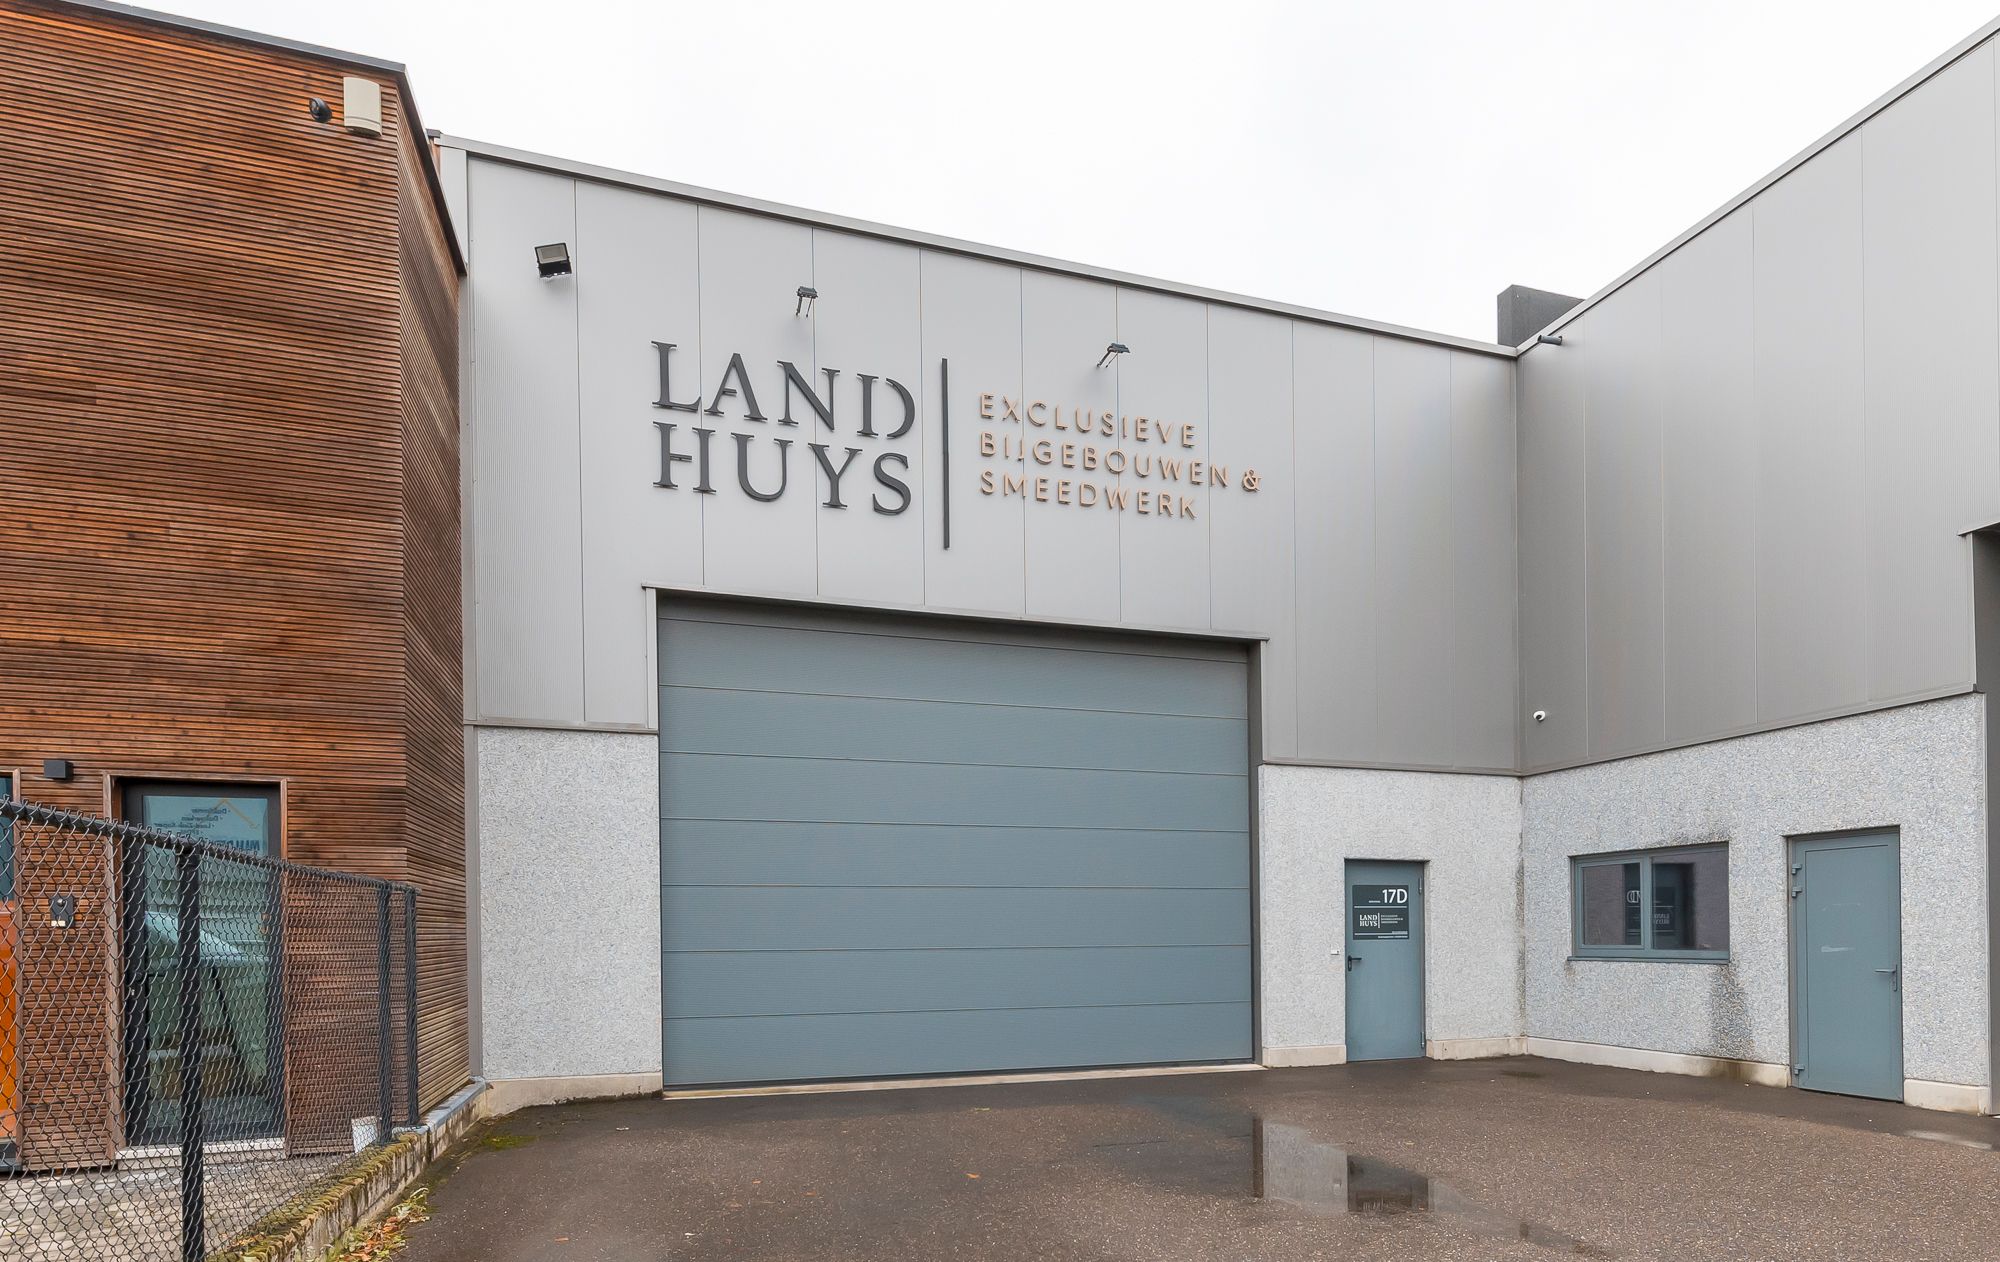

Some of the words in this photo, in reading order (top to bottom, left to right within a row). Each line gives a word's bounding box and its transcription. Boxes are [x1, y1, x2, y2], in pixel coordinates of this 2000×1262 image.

[651, 340, 915, 440] LAND
[980, 393, 1195, 448] EXCLUSIEVE
[653, 421, 911, 515] HUYS
[981, 432, 1229, 488] BIJGEBOUWEN
[1241, 466, 1262, 492] &
[980, 470, 1197, 519] SMEEDWERK
[1382, 888, 1408, 904] 17D
